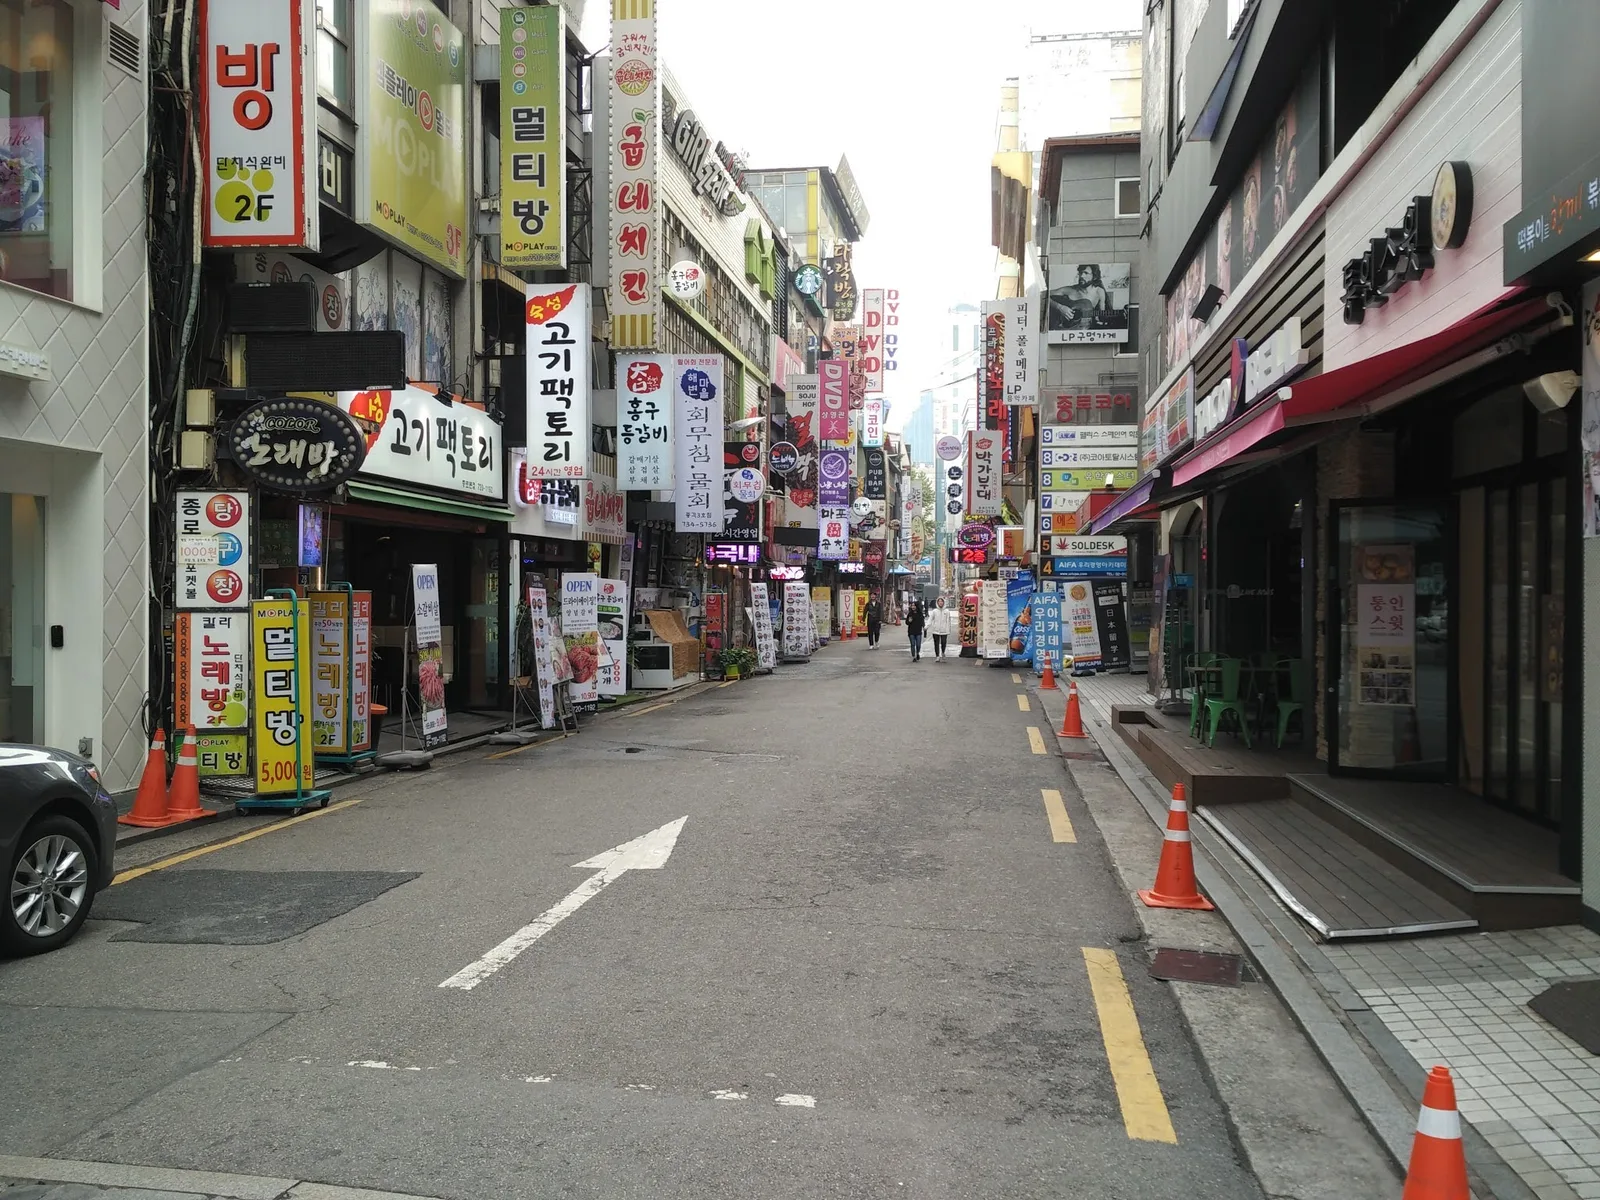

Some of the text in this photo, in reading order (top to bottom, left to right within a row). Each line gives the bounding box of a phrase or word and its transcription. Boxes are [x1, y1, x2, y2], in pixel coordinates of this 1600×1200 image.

[621, 33, 647, 44] 구워서
[616, 44, 653, 58] 굽네치킨!
[615, 68, 653, 85] 굽네치킨
[216, 43, 280, 131] 방
[511, 106, 549, 235] 멀티방
[234, 194, 275, 222] 2F
[619, 126, 650, 301] 굽네치킨
[446, 223, 462, 260] 3F
[505, 241, 545, 252] MOPLAY
[834, 244, 852, 299] 다락방
[529, 296, 562, 320] 숙성
[887, 289, 900, 326] DVD
[866, 311, 881, 373] DVD
[1061, 332, 1117, 342] LP구멍가게
[885, 334, 899, 371] DVD
[538, 322, 577, 462] 고기팩토리
[687, 373, 698, 397] 해변
[824, 363, 843, 410] DVD
[1006, 385, 1022, 395] LP
[626, 397, 660, 422] 홍구
[264, 416, 321, 433] COLOR
[867, 414, 879, 439] 코인
[620, 424, 668, 445] 등갈비
[1043, 430, 1053, 442] 9
[390, 408, 494, 479] 고기팩토리
[248, 432, 339, 480] 노래방
[1043, 452, 1053, 464] 8
[531, 465, 583, 477] 24시간 영업
[975, 451, 993, 501] 박가부대
[1043, 473, 1053, 485] 8
[732, 480, 761, 490] 회무침
[949, 468, 961, 513] 노래방
[584, 481, 624, 523] 굽네치킨
[1043, 495, 1052, 508] 7
[181, 498, 202, 535] 종로
[821, 508, 847, 519] 마포
[1043, 517, 1052, 530] 6
[963, 533, 989, 543] 노래방
[1042, 539, 1051, 552] 5
[1071, 541, 1115, 550] SOLDESK
[180, 547, 217, 558] 1000원
[715, 544, 758, 563] 국내
[962, 549, 986, 563] 2층
[839, 563, 864, 573] 부동산
[1042, 560, 1053, 575] 4
[416, 574, 435, 590] OPEN
[566, 580, 592, 592] OPEN
[1033, 596, 1059, 604] AIFA
[1369, 595, 1405, 612] 통인
[416, 601, 439, 617] 소갈비살
[202, 617, 232, 629] 칼라
[963, 599, 977, 644] 노래방
[1034, 608, 1059, 661] 우리경영 아카데미
[201, 634, 231, 712] 노래방
[317, 633, 341, 719] 노래방
[354, 633, 367, 716] 노래방
[263, 627, 304, 746] 멀티방
[206, 715, 228, 725] 2F
[320, 734, 336, 745] 2F
[356, 733, 365, 744] 2F
[201, 752, 243, 770] 티방
